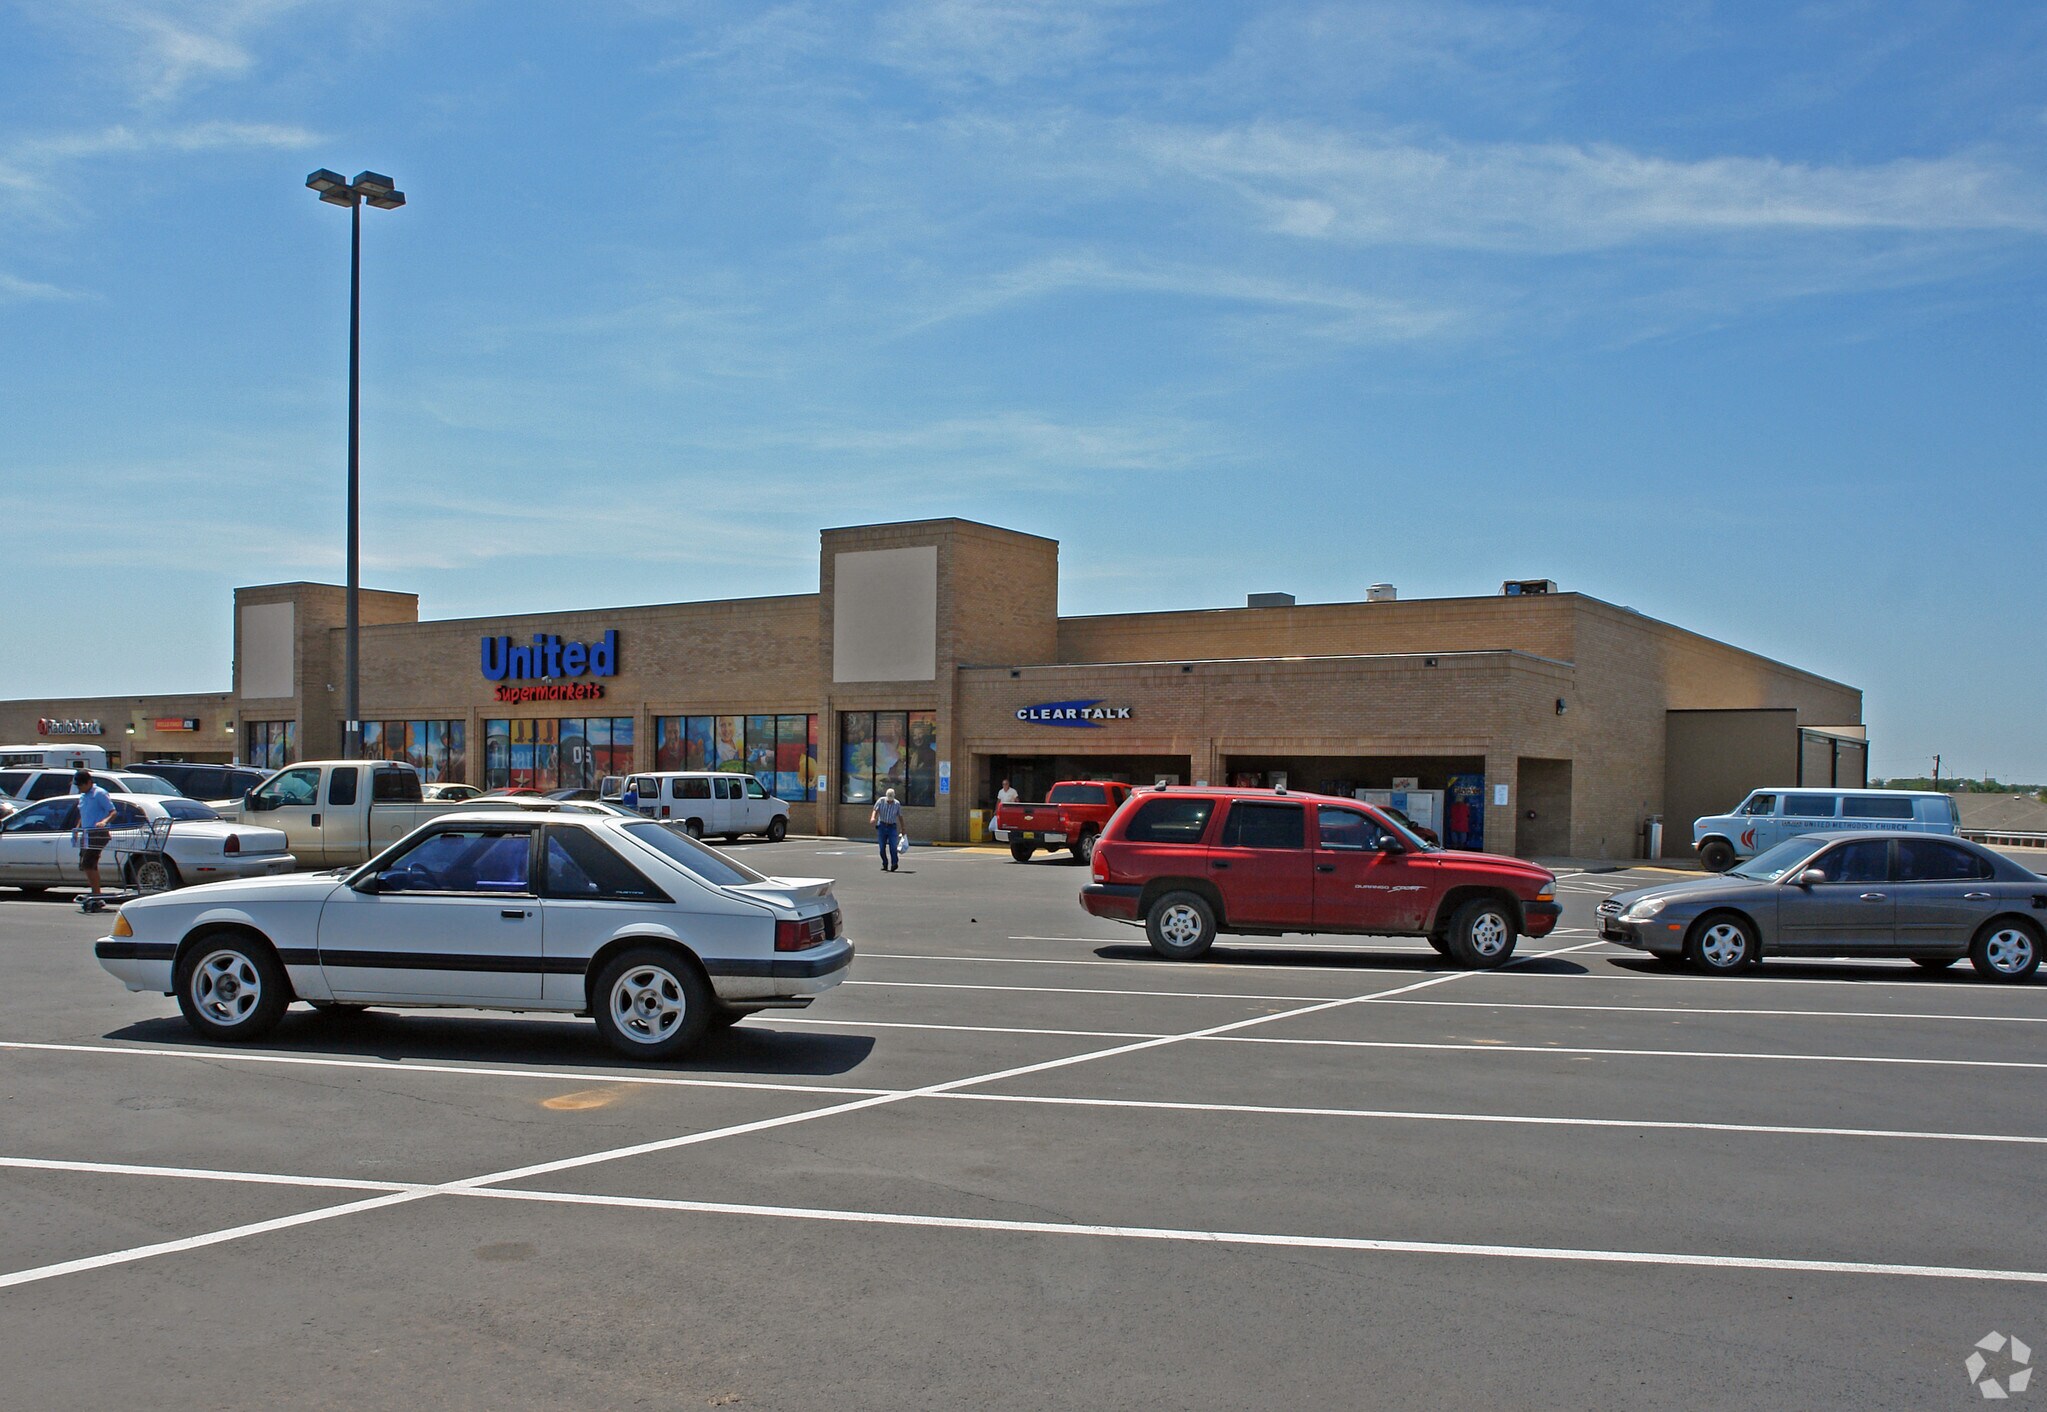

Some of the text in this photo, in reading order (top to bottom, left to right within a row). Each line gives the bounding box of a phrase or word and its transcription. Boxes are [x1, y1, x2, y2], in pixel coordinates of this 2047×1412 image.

[481, 629, 618, 681] United
[493, 682, 603, 704] Supermarkets
[1017, 707, 1131, 720] CLEAR TALK
[47, 719, 100, 735] RadioShack
[1804, 821, 1830, 829] UNITED
[1832, 822, 1874, 830] METHODIST
[1875, 823, 1908, 831] CHURCH
